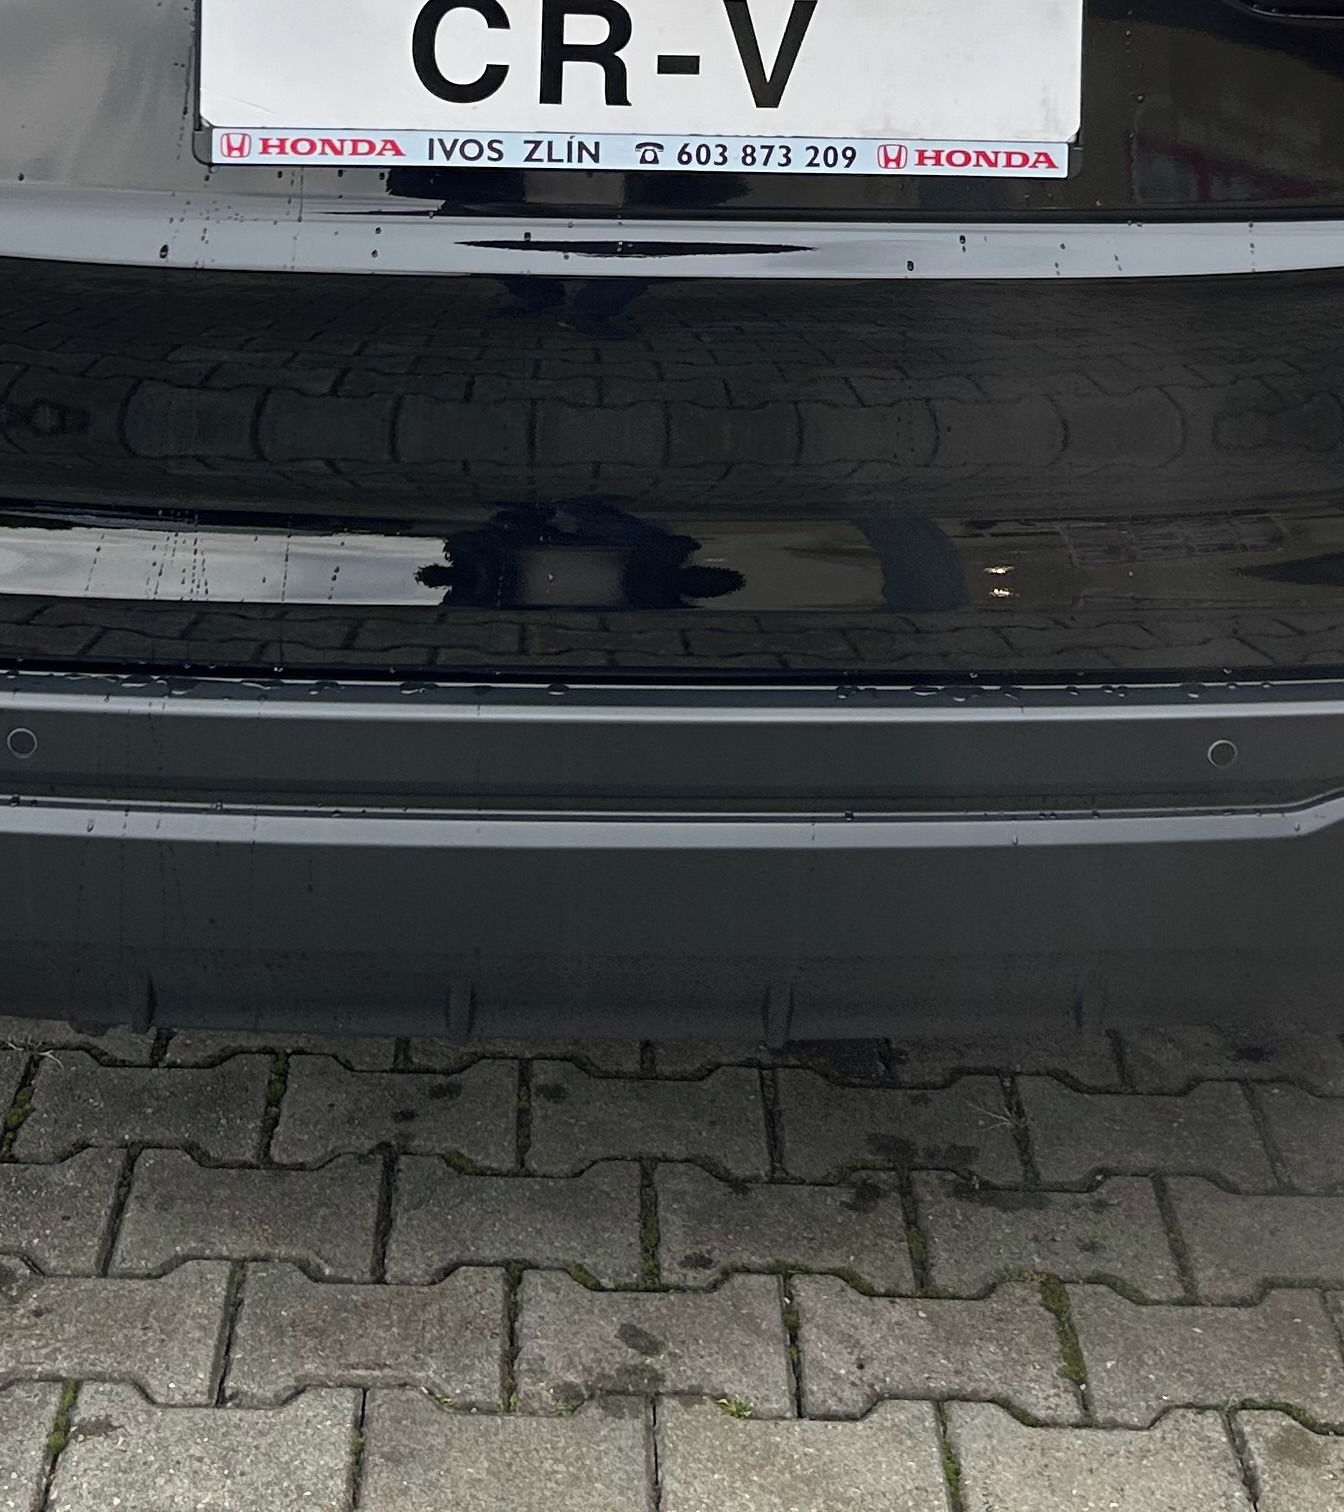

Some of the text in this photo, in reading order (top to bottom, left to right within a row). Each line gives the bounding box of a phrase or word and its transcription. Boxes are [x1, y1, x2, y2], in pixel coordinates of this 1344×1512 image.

[258, 135, 1059, 170] HONDA IVOS ZLÍN 603 873 209 HONDA
